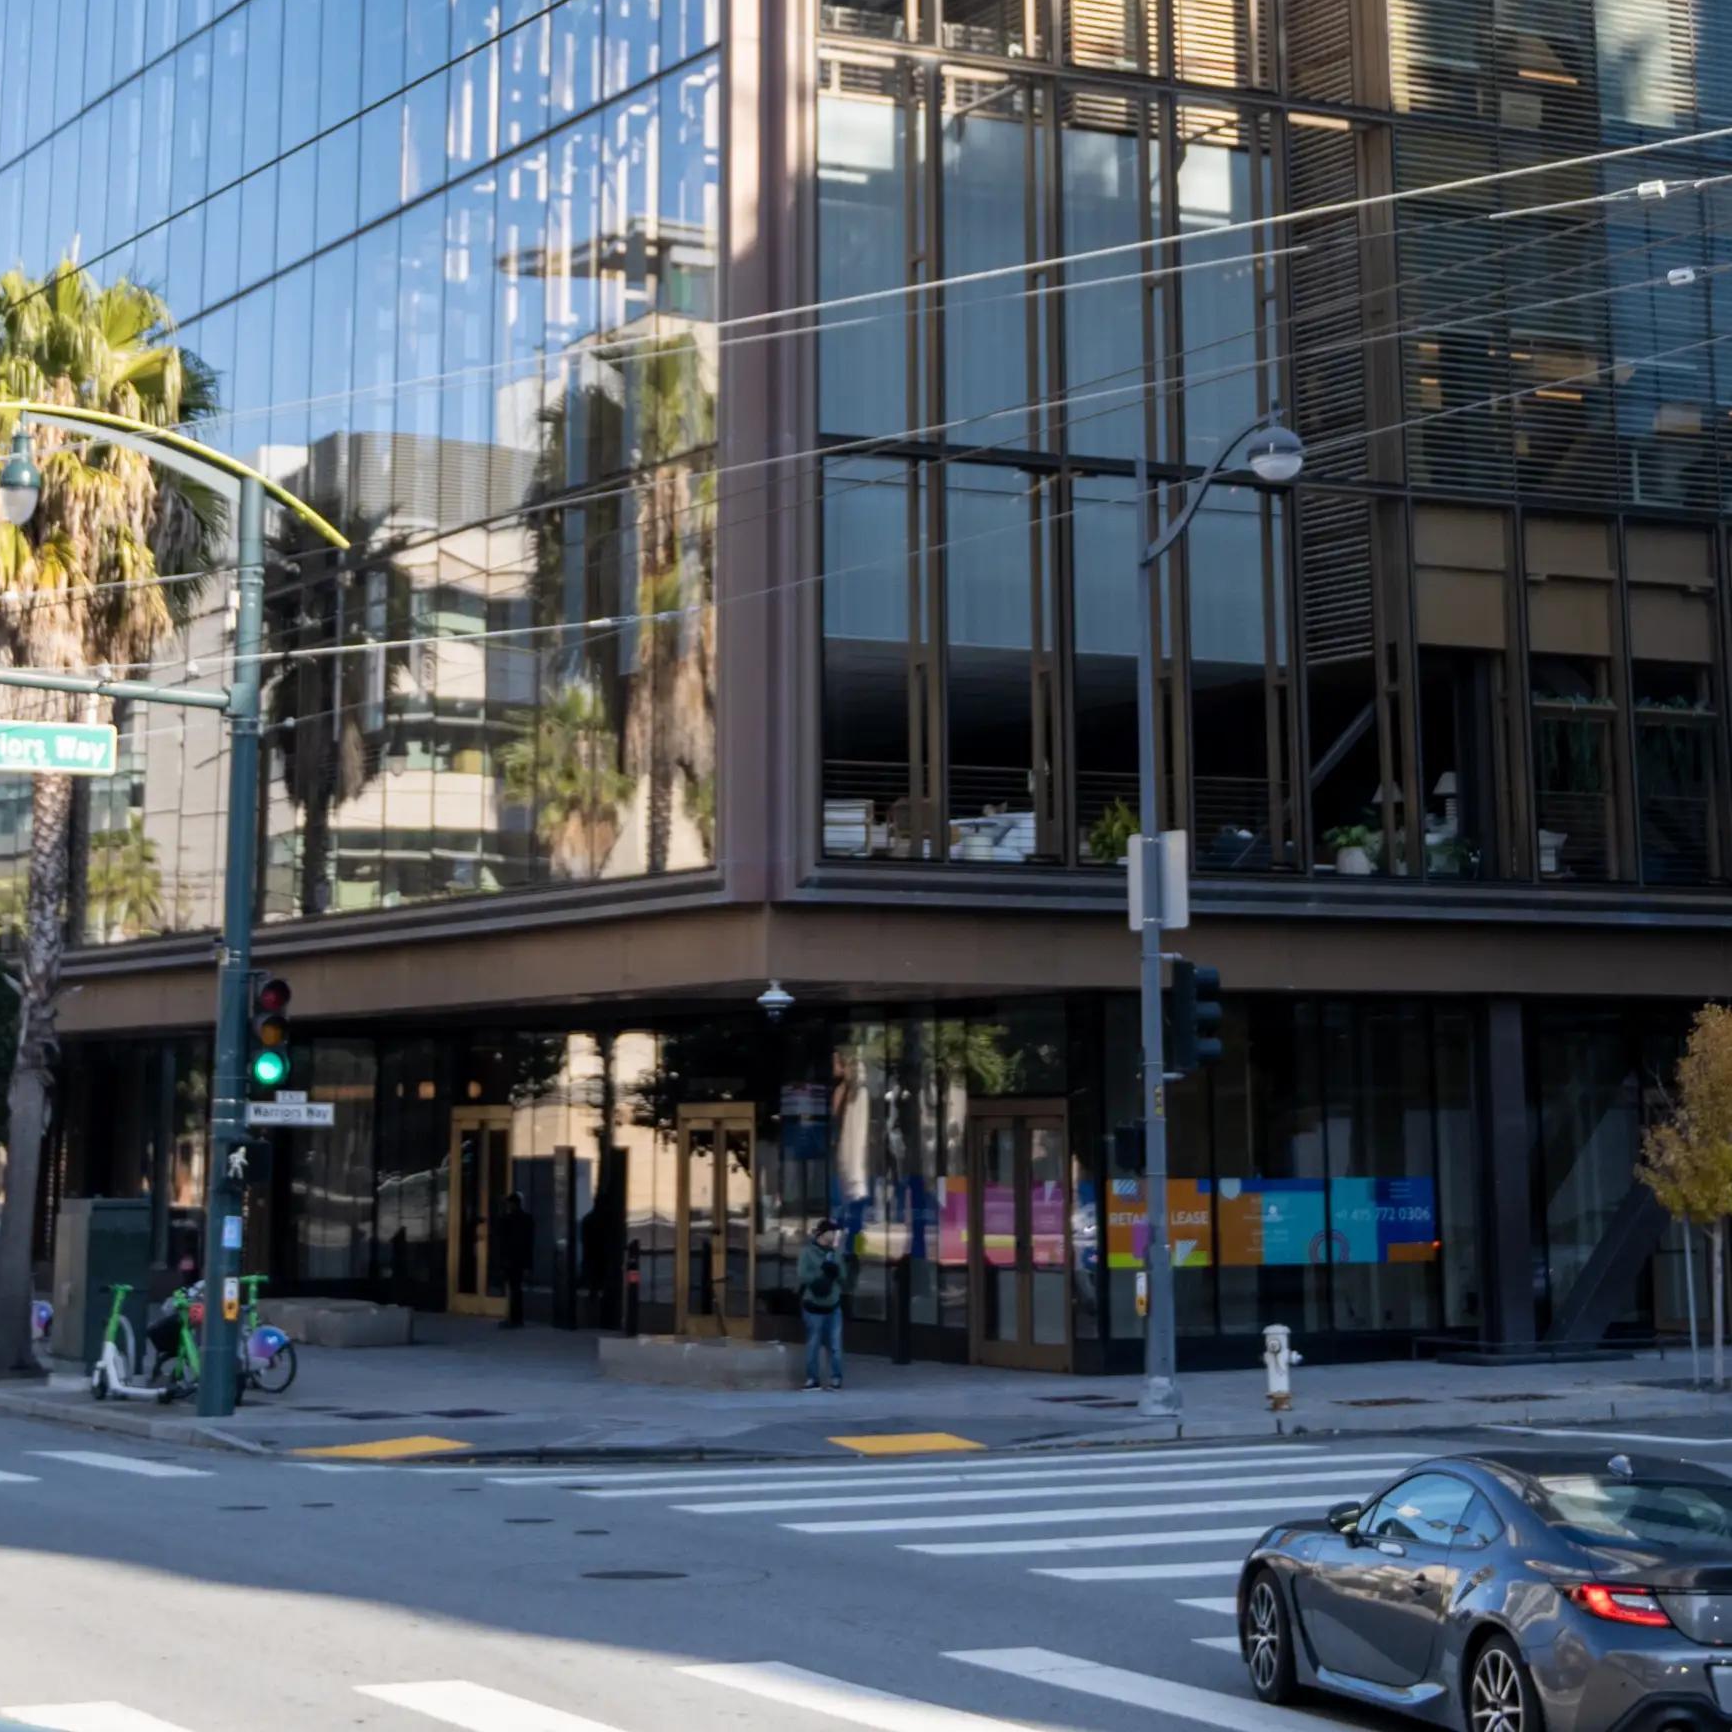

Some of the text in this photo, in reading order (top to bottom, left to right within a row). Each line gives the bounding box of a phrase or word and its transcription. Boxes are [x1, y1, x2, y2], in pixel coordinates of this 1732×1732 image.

[54, 734, 106, 767] Way
[252, 1105, 329, 1120] Warriors Way
[1109, 1211, 1209, 1225] RETAI LEASE
[1375, 1206, 1396, 1221] 772
[1398, 1205, 1431, 1221] 0306
